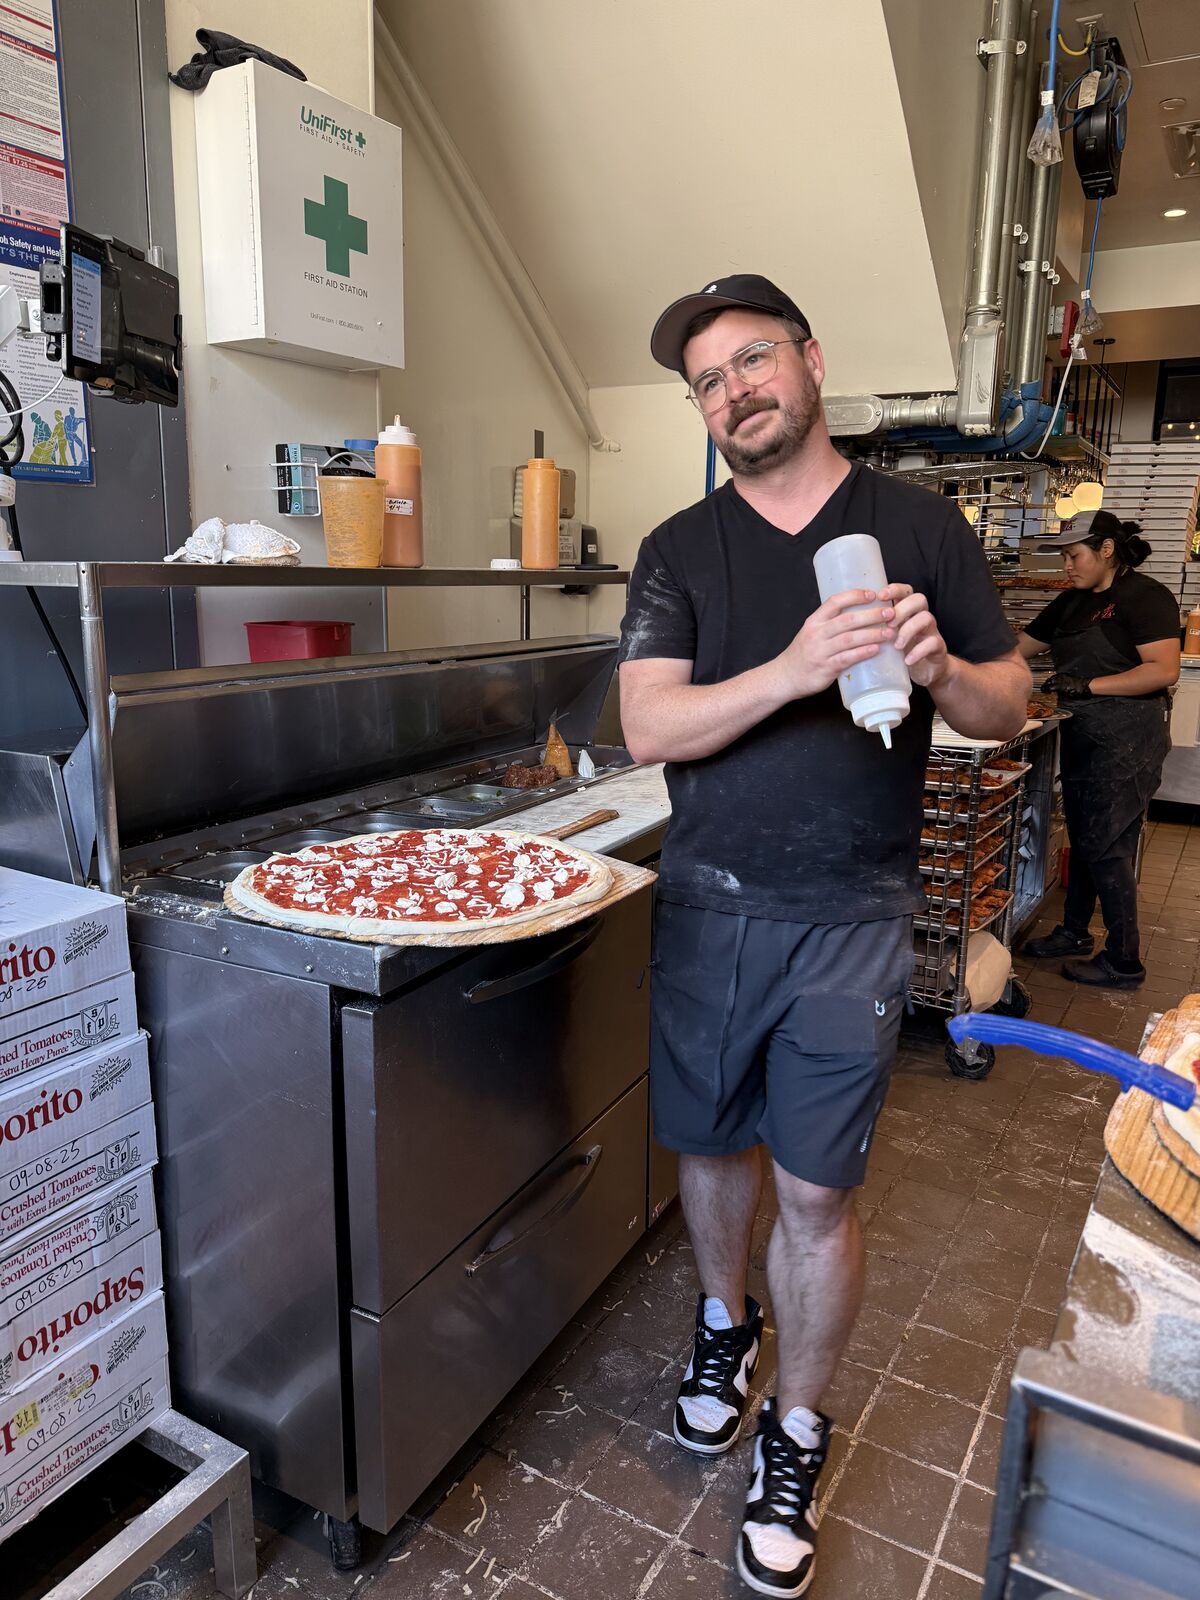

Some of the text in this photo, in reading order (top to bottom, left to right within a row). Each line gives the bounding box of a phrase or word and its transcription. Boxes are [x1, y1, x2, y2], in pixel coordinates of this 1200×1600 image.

[300, 124, 318, 137] FIRST
[321, 134, 332, 143] AID
[342, 143, 366, 158] SAFETY
[301, 106, 352, 143] UniFirst
[9, 236, 31, 252] Safety
[32, 244, 45, 253] and
[18, 250, 39, 263] THE
[304, 271, 368, 298] FIRST AID STATION
[21, 1029, 73, 1056] Tomatoes
[21, 1054, 46, 1070] Heavy
[47, 1045, 69, 1059] Puree
[0, 1088, 83, 1147] orito
[10, 1140, 80, 1191] 09-08-25
[1, 1164, 96, 1220] Crushed Tomatoes
[7, 1182, 93, 1231] with Extra Heavy Puree
[0, 1228, 97, 1289] Crushed Tomatoes
[2, 1217, 90, 1272] with Extra Heavy Puree
[16, 1258, 84, 1312] 09-08-25
[17, 1266, 144, 1362] Saporito
[16, 1423, 111, 1496] Crushed Tomatoes
[22, 1438, 108, 1505] with Extra Heavy Puree
